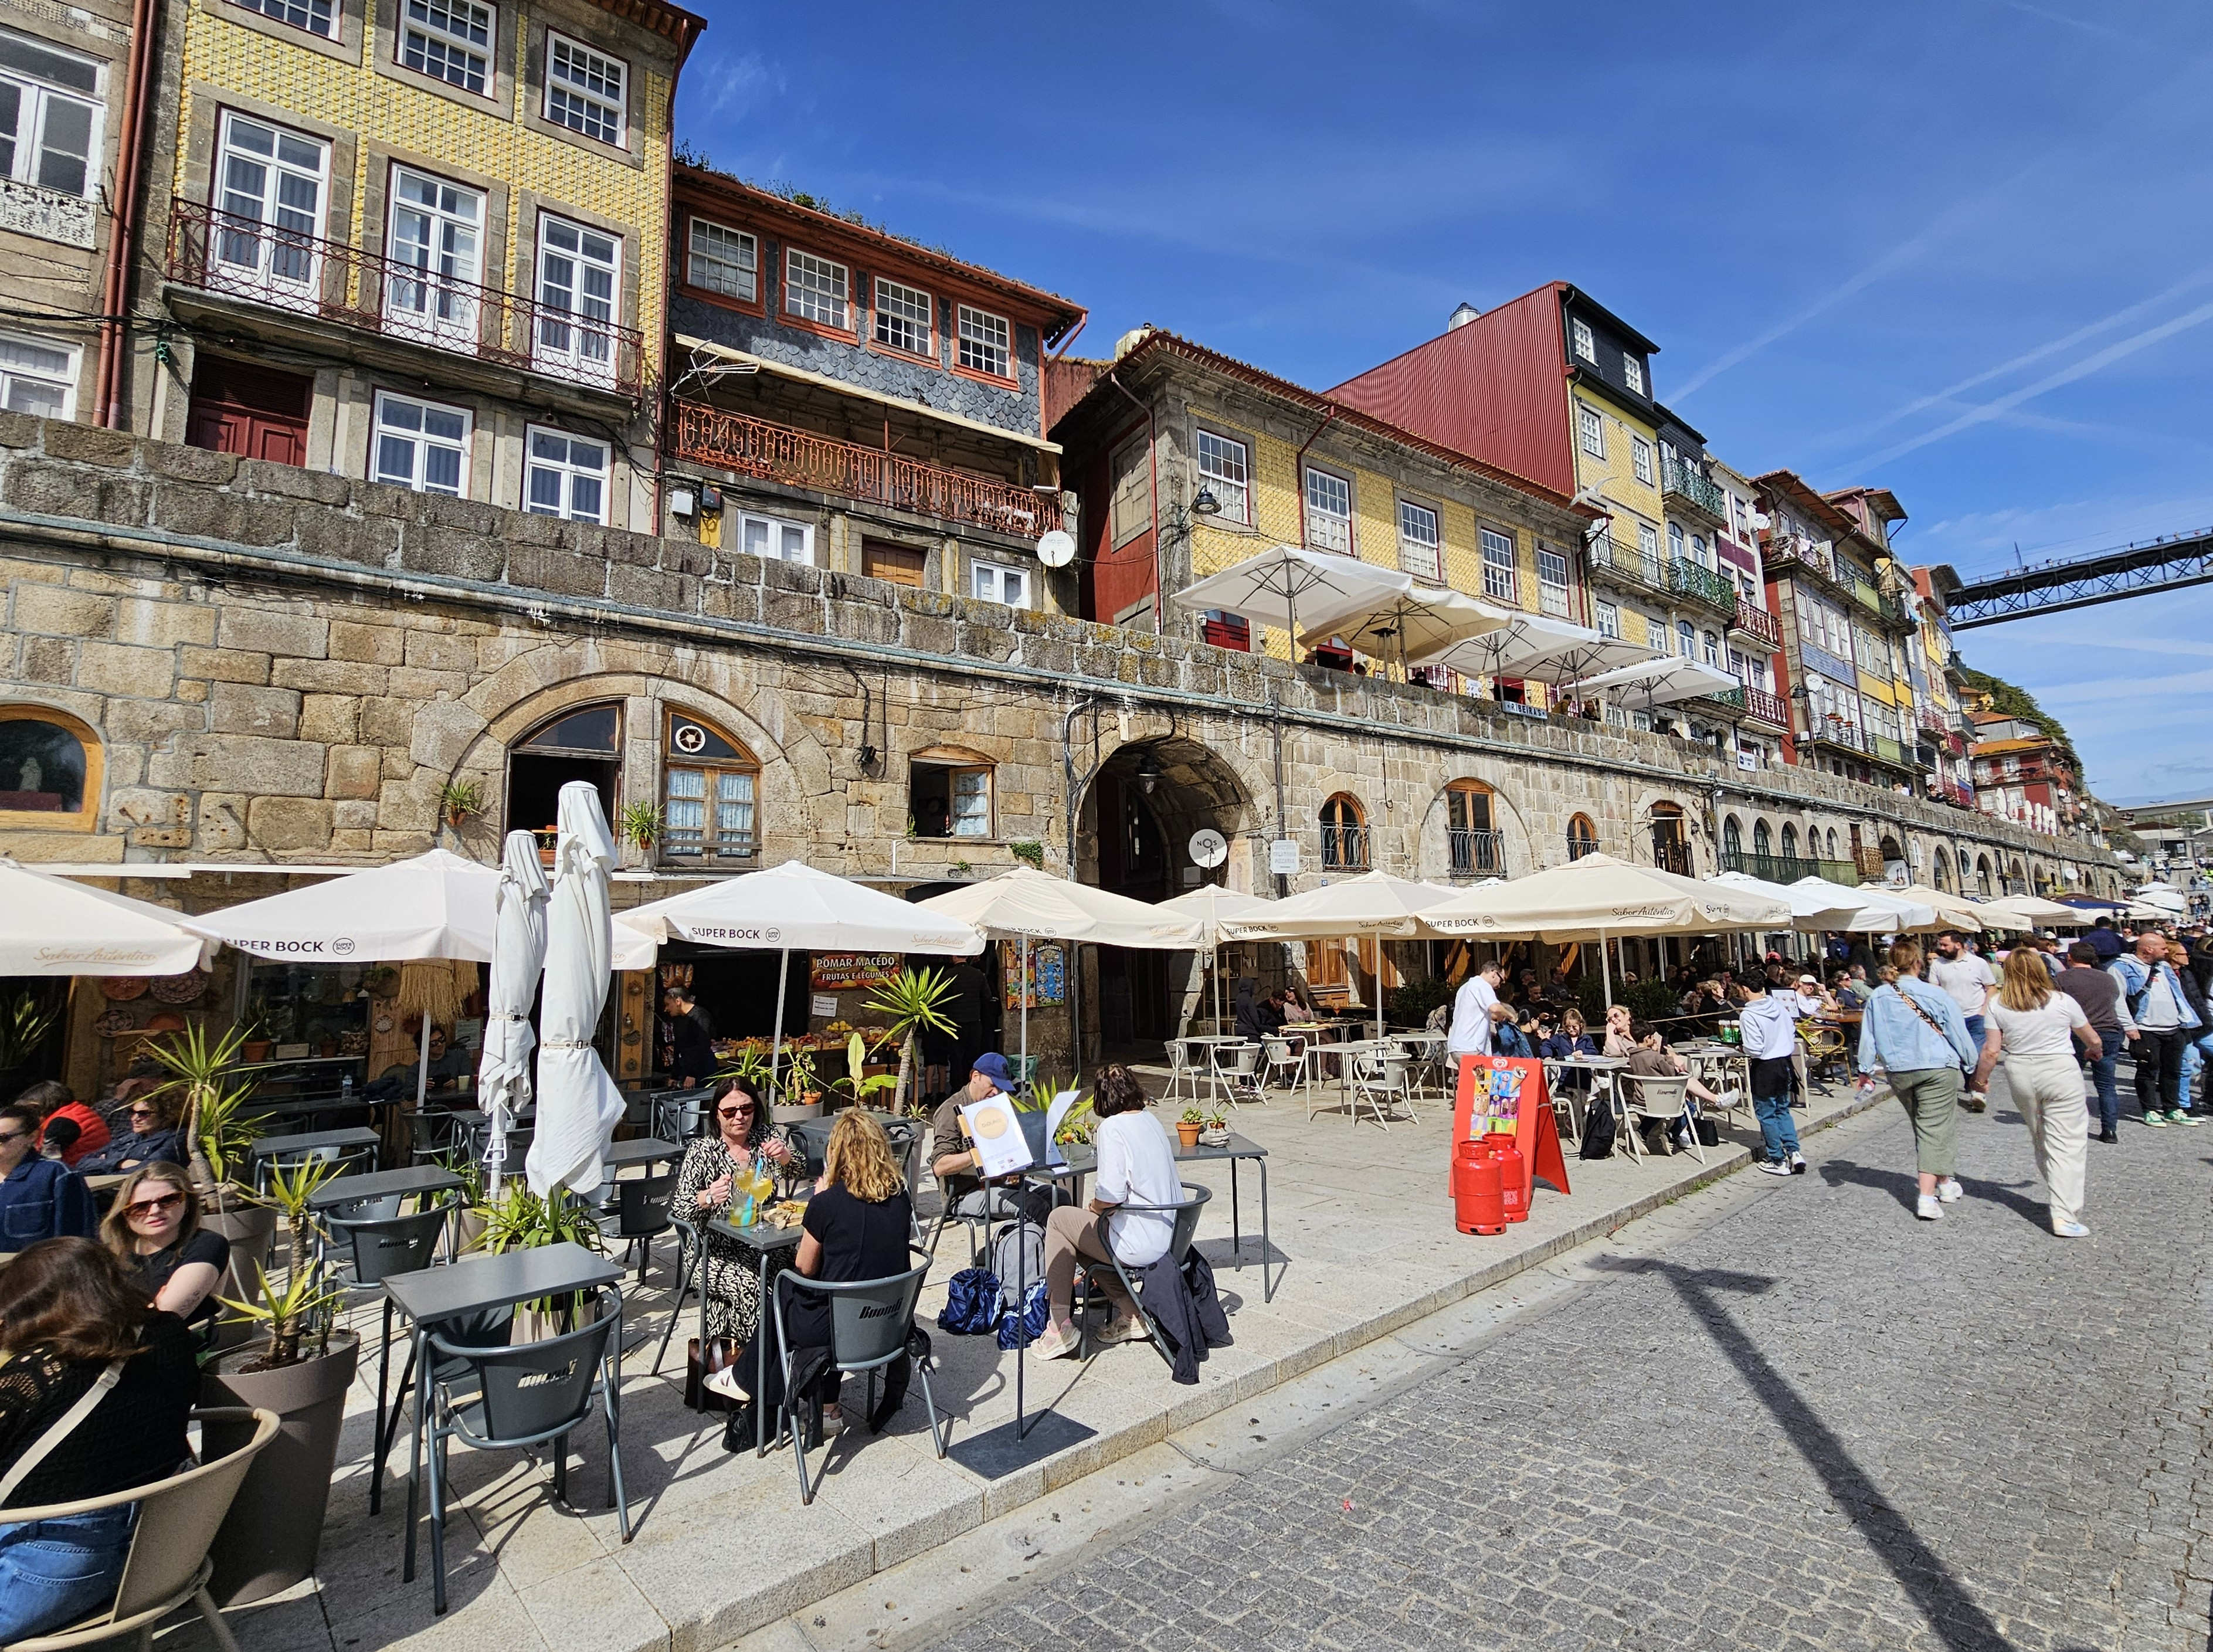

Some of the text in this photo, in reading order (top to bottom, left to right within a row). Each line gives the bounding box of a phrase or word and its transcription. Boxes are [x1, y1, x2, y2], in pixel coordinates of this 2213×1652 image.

[1511, 703, 1542, 716] RIBEIRAS
[1197, 838, 1217, 848] NOS
[1612, 907, 1638, 916] Sabor
[1425, 920, 1453, 928] SUPER
[1455, 918, 1479, 927] BOCK
[691, 927, 760, 939] SUPER BOCK
[1226, 924, 1247, 935] SUPER
[275, 941, 324, 952] BOCK
[816, 956, 895, 968] POMAR MACEDO
[822, 972, 850, 981] FRUTAS
[858, 971, 890, 980] LEGUMES
